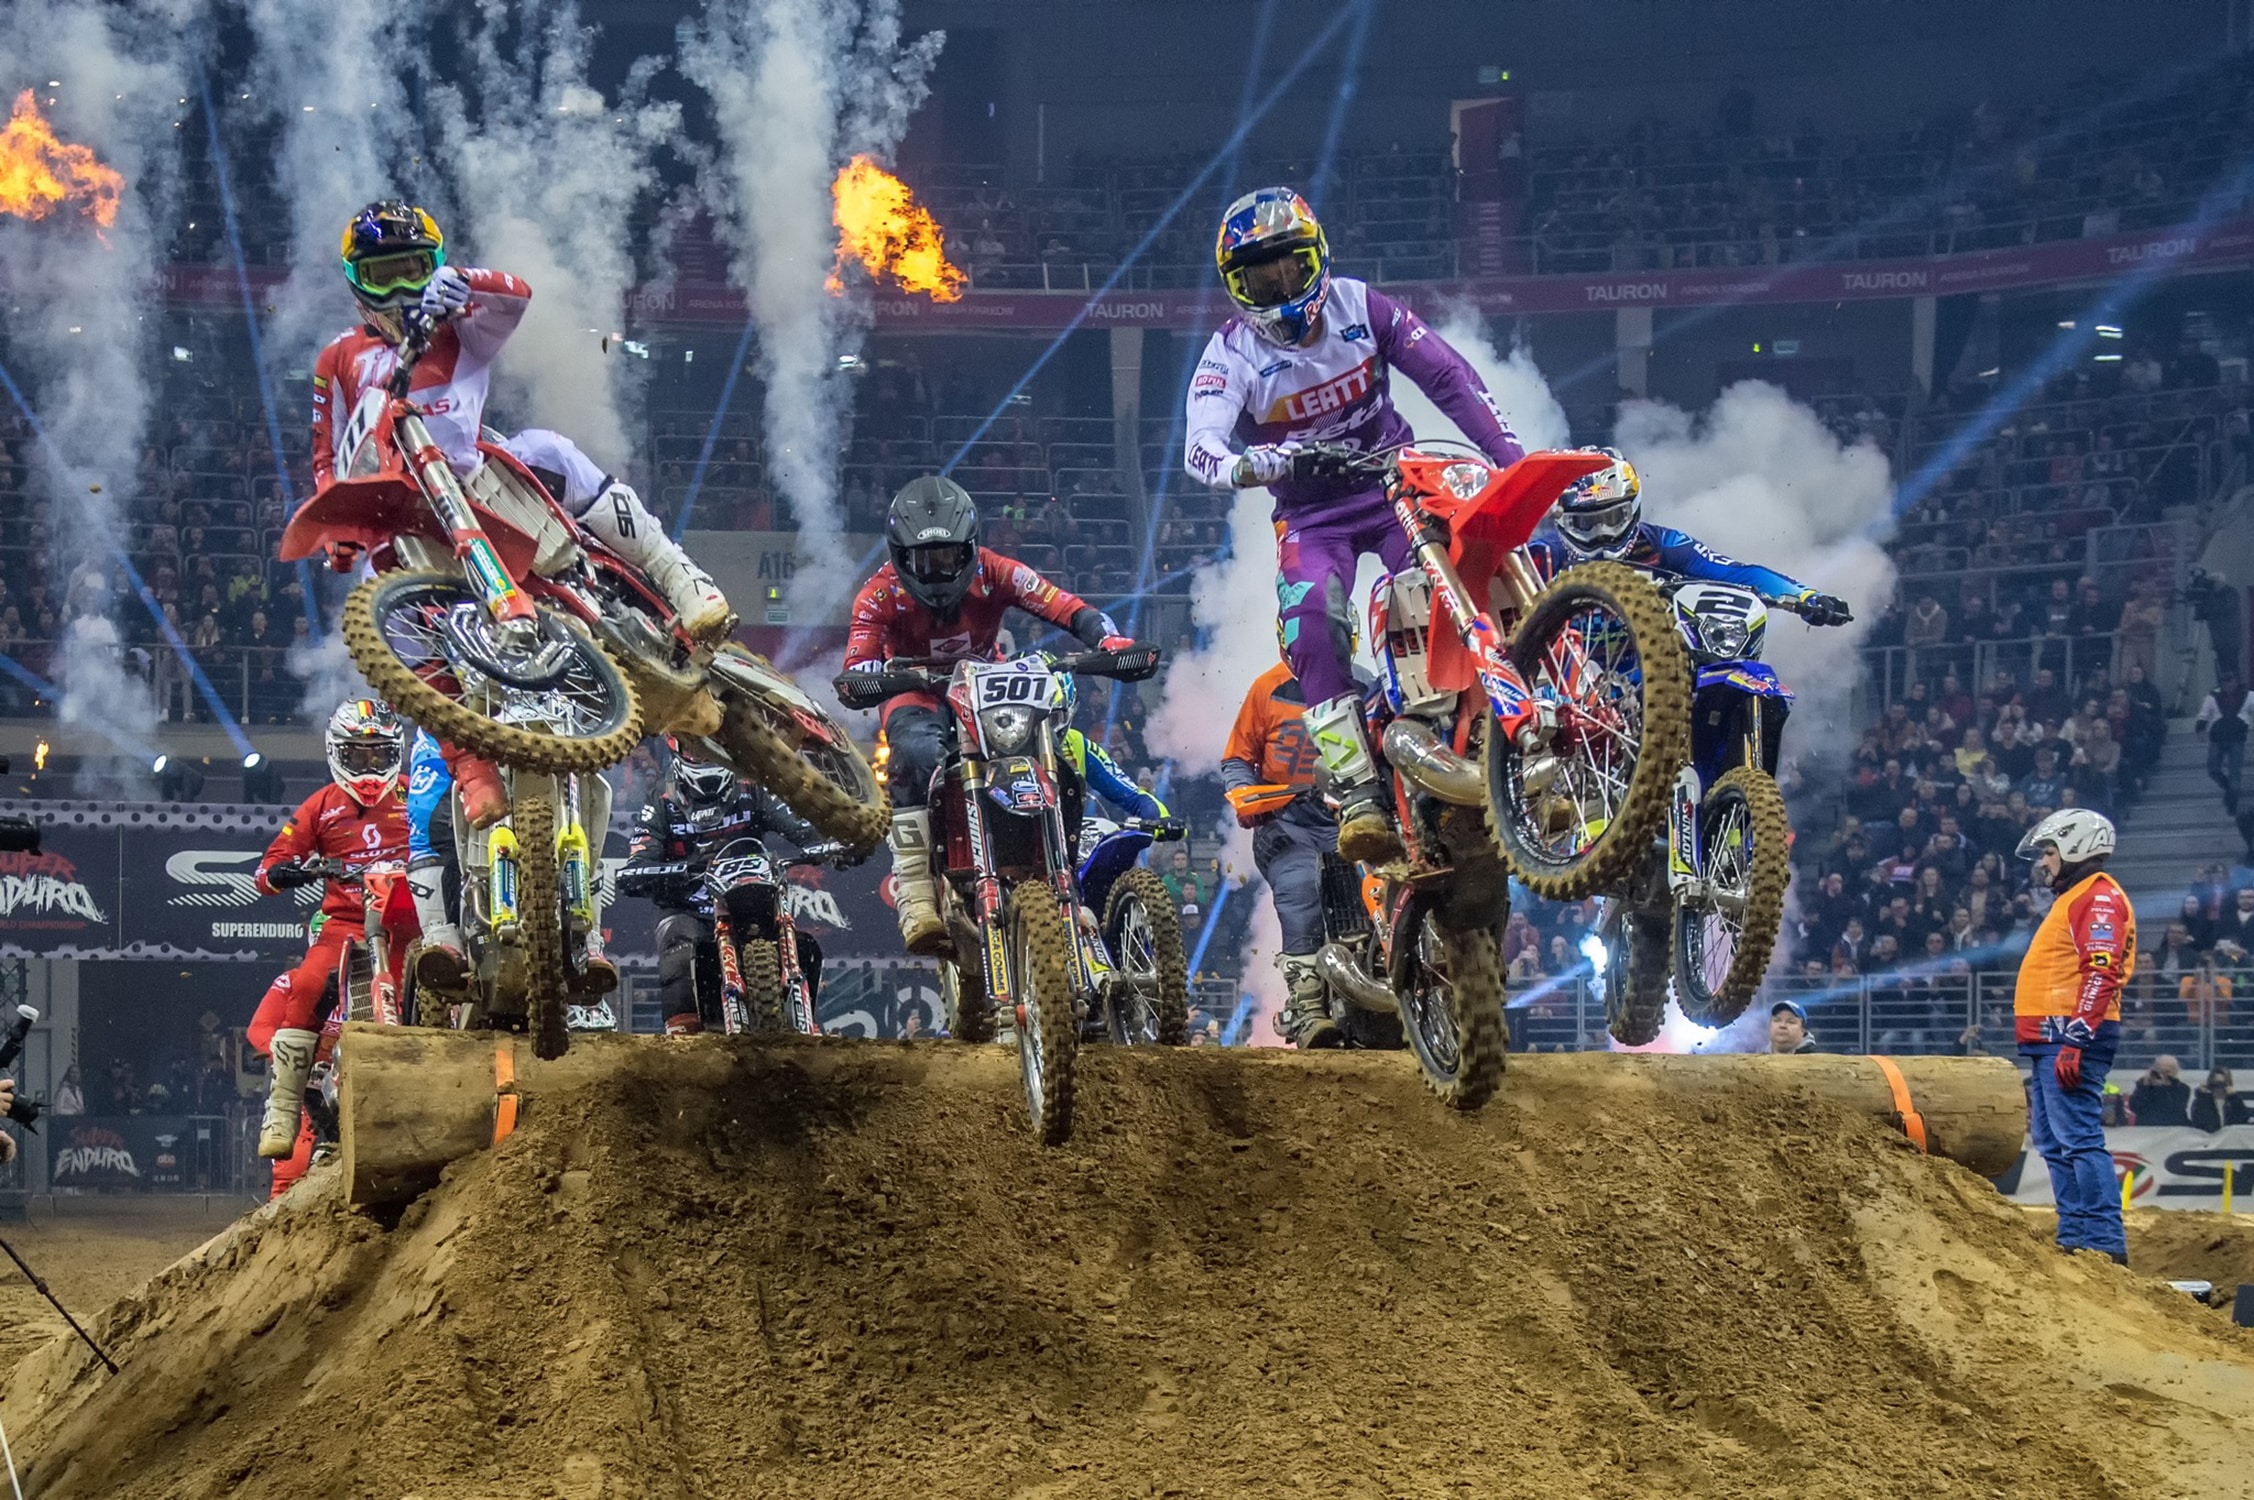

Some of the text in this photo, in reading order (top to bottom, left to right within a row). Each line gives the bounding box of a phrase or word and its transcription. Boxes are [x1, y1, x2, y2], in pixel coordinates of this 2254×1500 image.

[1841, 271, 1928, 290] TAURON
[1584, 283, 1668, 302] TAURON
[1085, 302, 1164, 319] TAURON
[1284, 366, 1370, 421] LEATT
[983, 676, 1048, 703] 501
[616, 863, 688, 879] RIEJU
[53, 1145, 141, 1183] ENDURO
